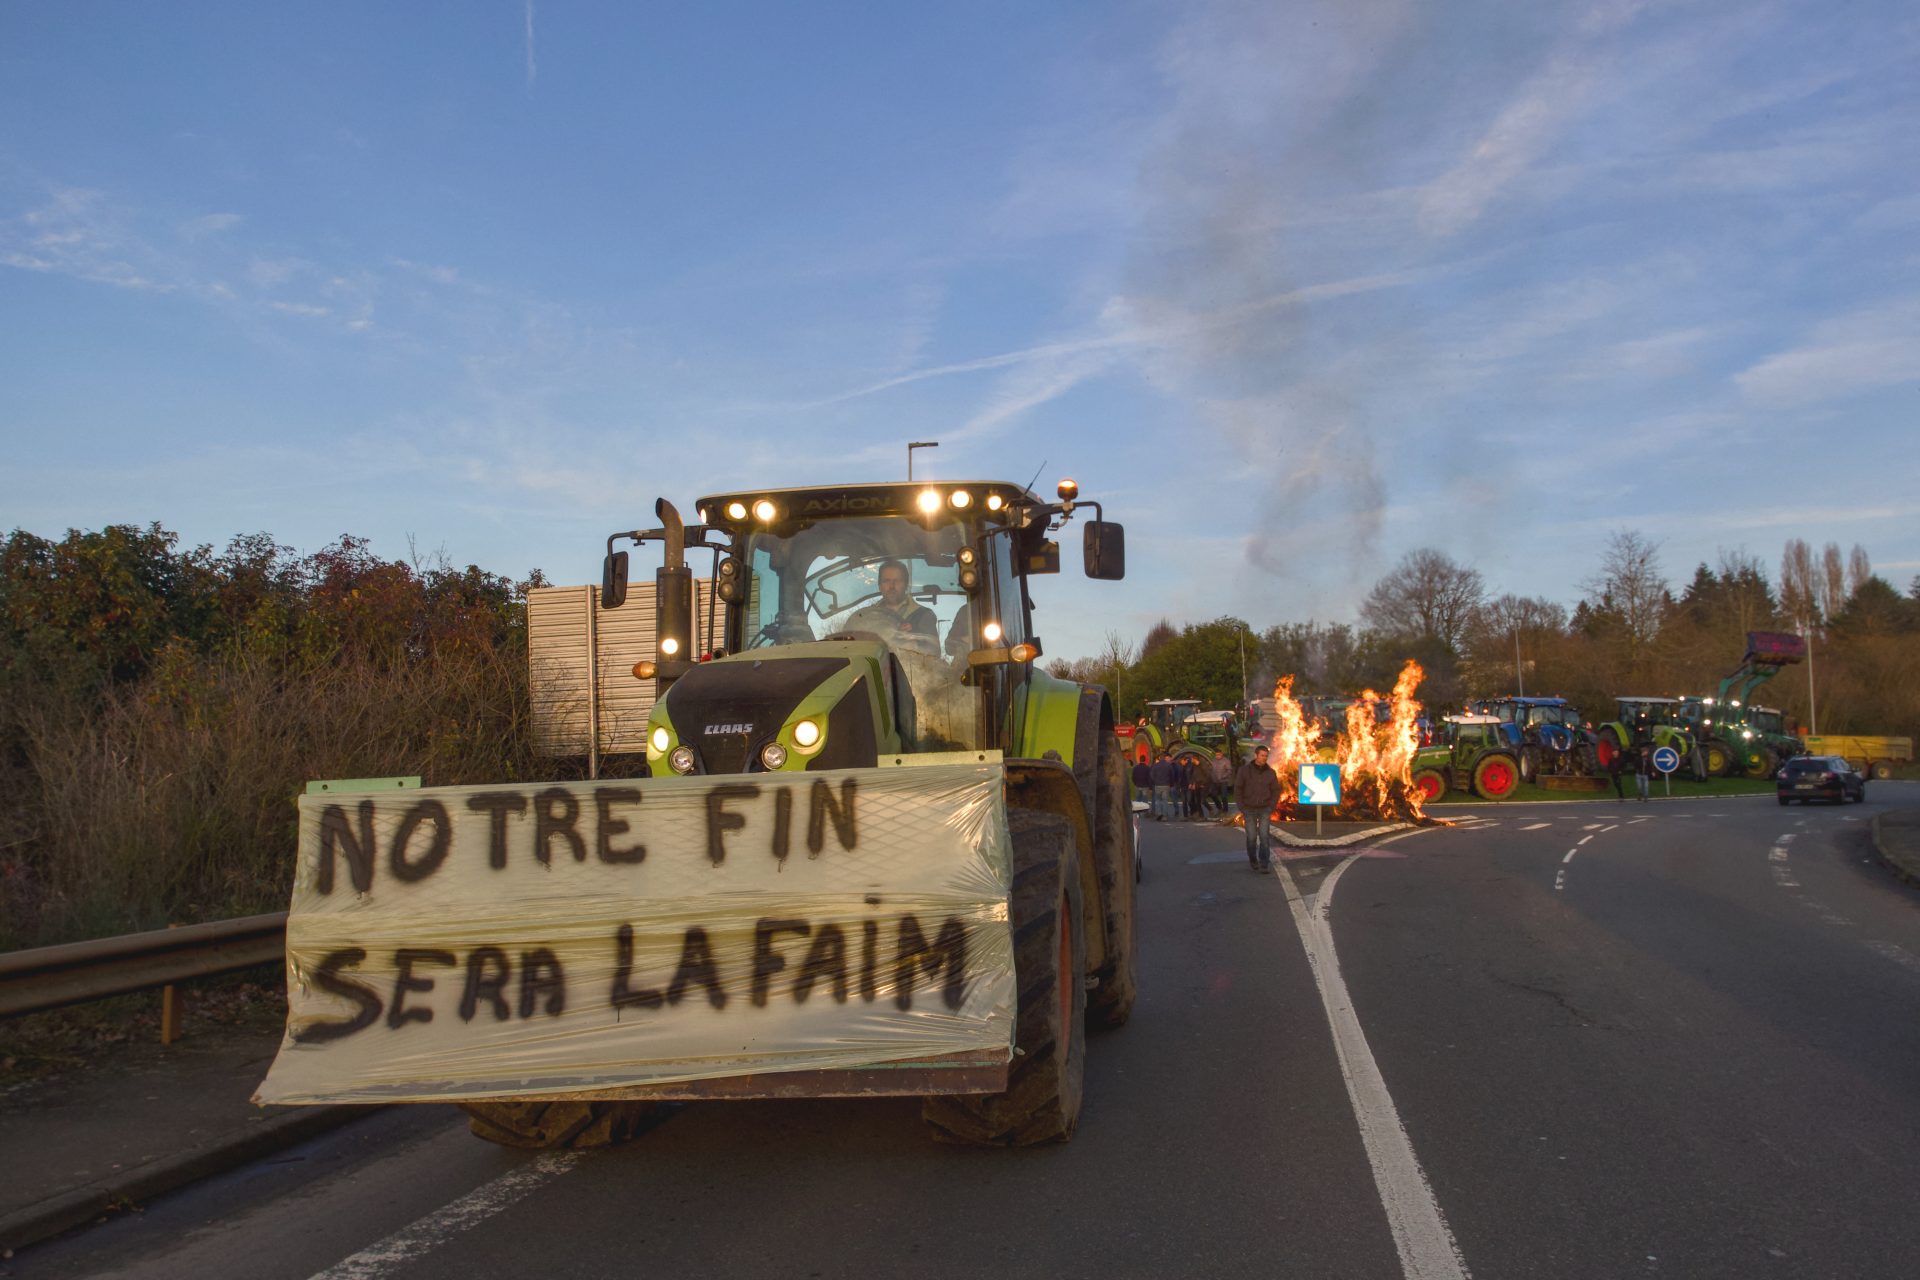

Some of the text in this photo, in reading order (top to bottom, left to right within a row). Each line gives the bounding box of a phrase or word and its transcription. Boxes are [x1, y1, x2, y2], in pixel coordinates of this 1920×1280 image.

[803, 497, 893, 512] AXION
[704, 723, 753, 735] CLAAS
[317, 777, 859, 897] NOTRE FIN
[293, 945, 567, 1045] SERA
[610, 923, 728, 1012] LA
